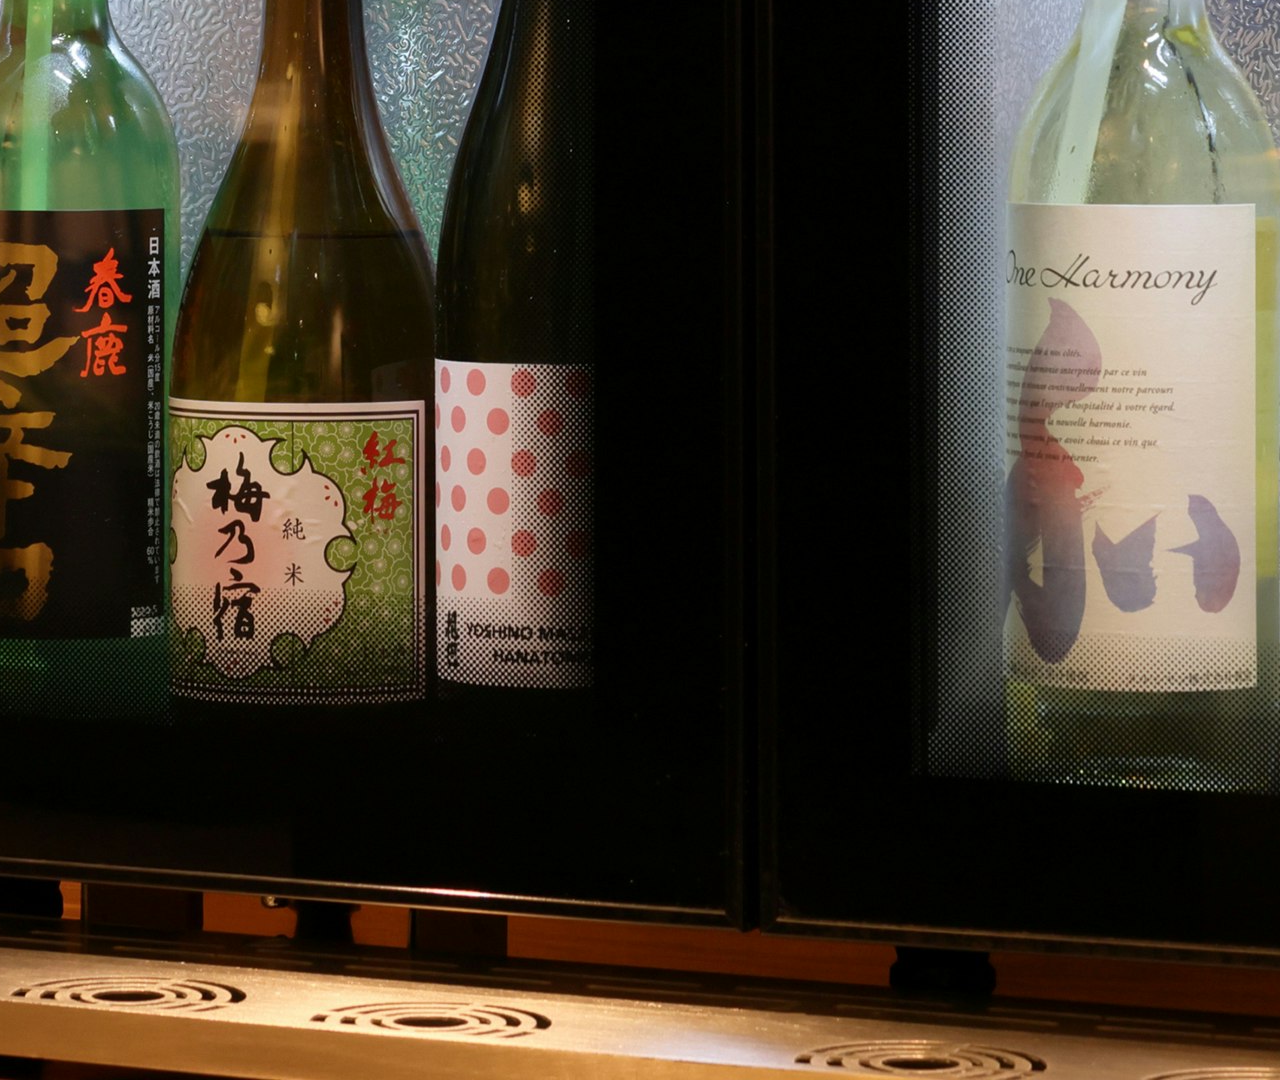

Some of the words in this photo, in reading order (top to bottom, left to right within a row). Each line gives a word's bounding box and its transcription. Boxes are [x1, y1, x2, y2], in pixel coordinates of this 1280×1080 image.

[147, 236, 160, 299] 日本酒
[1006, 250, 1039, 286] One
[1040, 253, 1218, 306] Harmony
[73, 247, 133, 378] 春鹿
[1132, 368, 1147, 377] vin
[1136, 387, 1174, 397] parcours
[1124, 438, 1138, 446] vin
[1141, 439, 1158, 448] que
[362, 430, 406, 525] 紅梅
[206, 451, 271, 642] 梅乃宿
[282, 518, 306, 586] 純米
